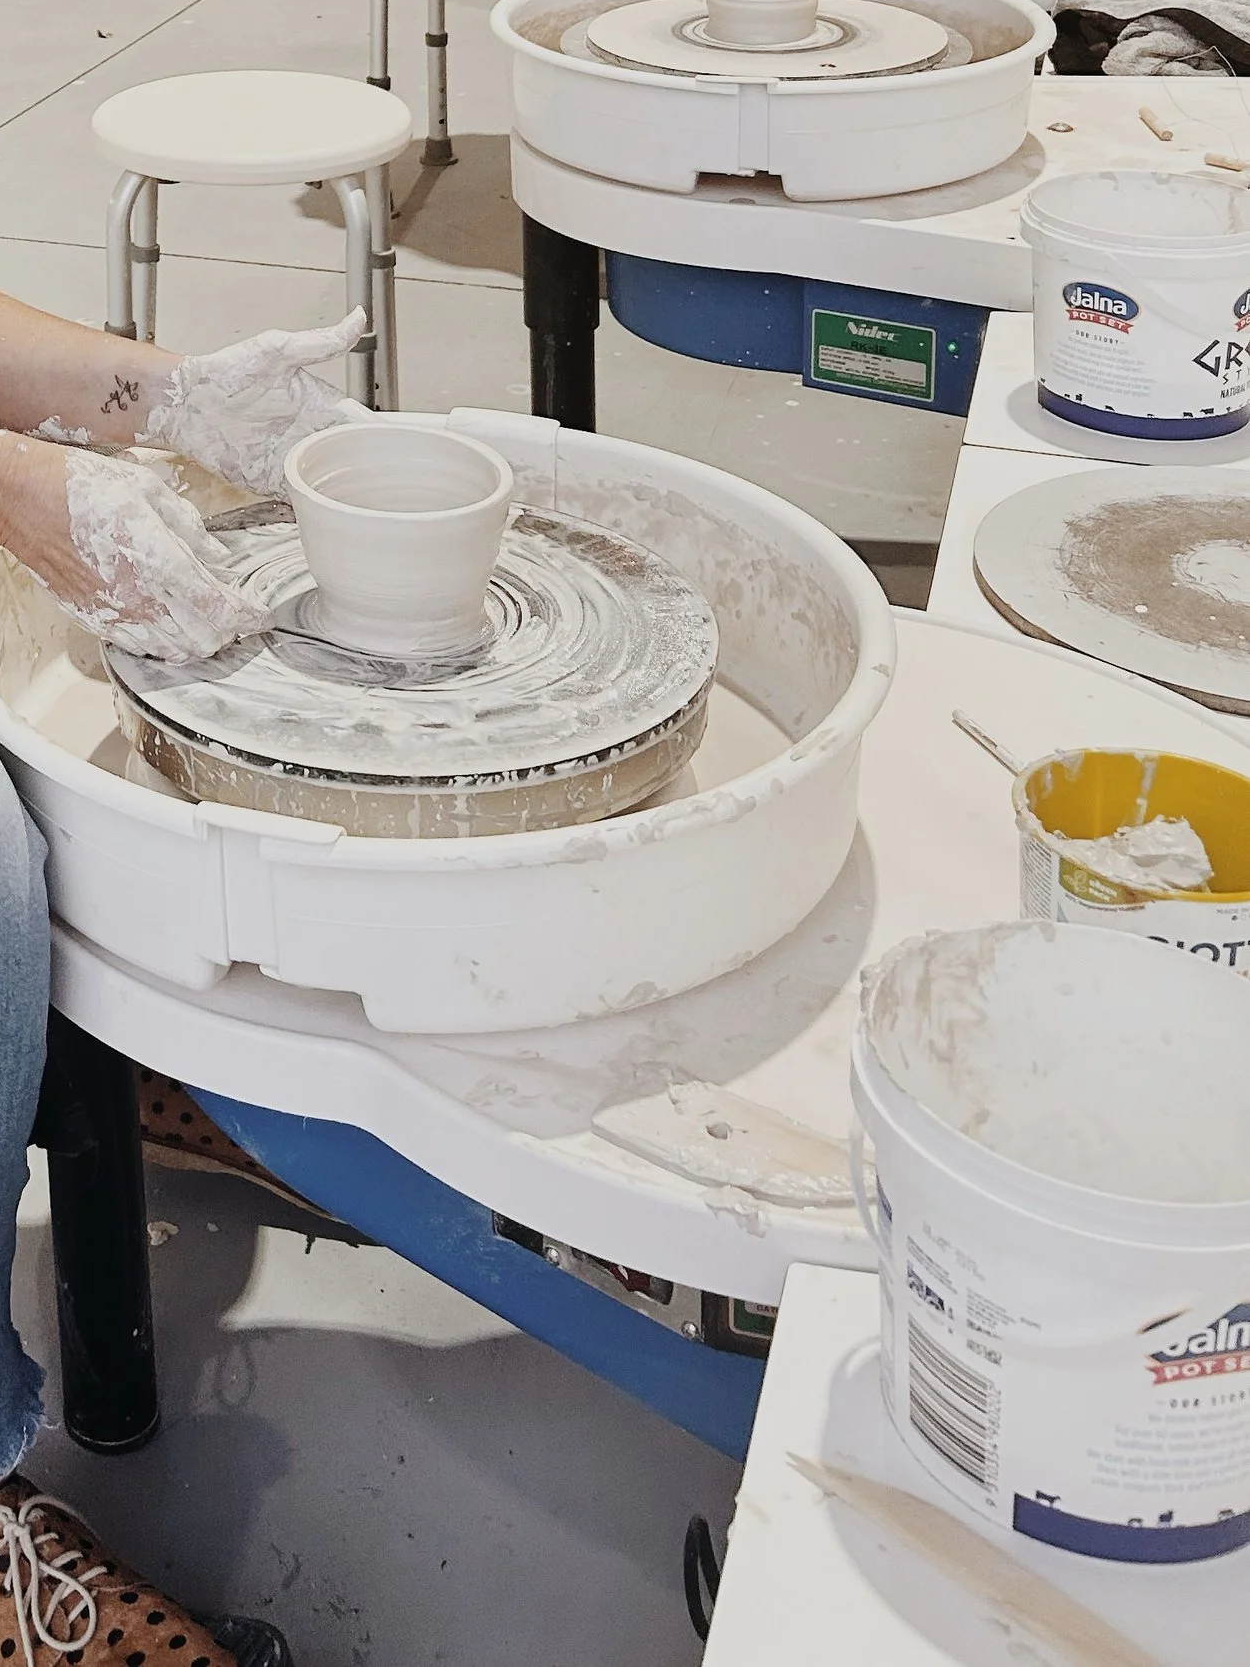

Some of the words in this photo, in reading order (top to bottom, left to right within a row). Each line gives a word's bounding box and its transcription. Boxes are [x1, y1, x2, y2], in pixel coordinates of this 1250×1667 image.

[1070, 286, 1127, 316] Jalna
[1072, 311, 1095, 321] POT
[1099, 315, 1126, 330] SET
[846, 321, 901, 343] Nidec
[1192, 339, 1250, 377] GR
[1163, 1362, 1218, 1381] POT
